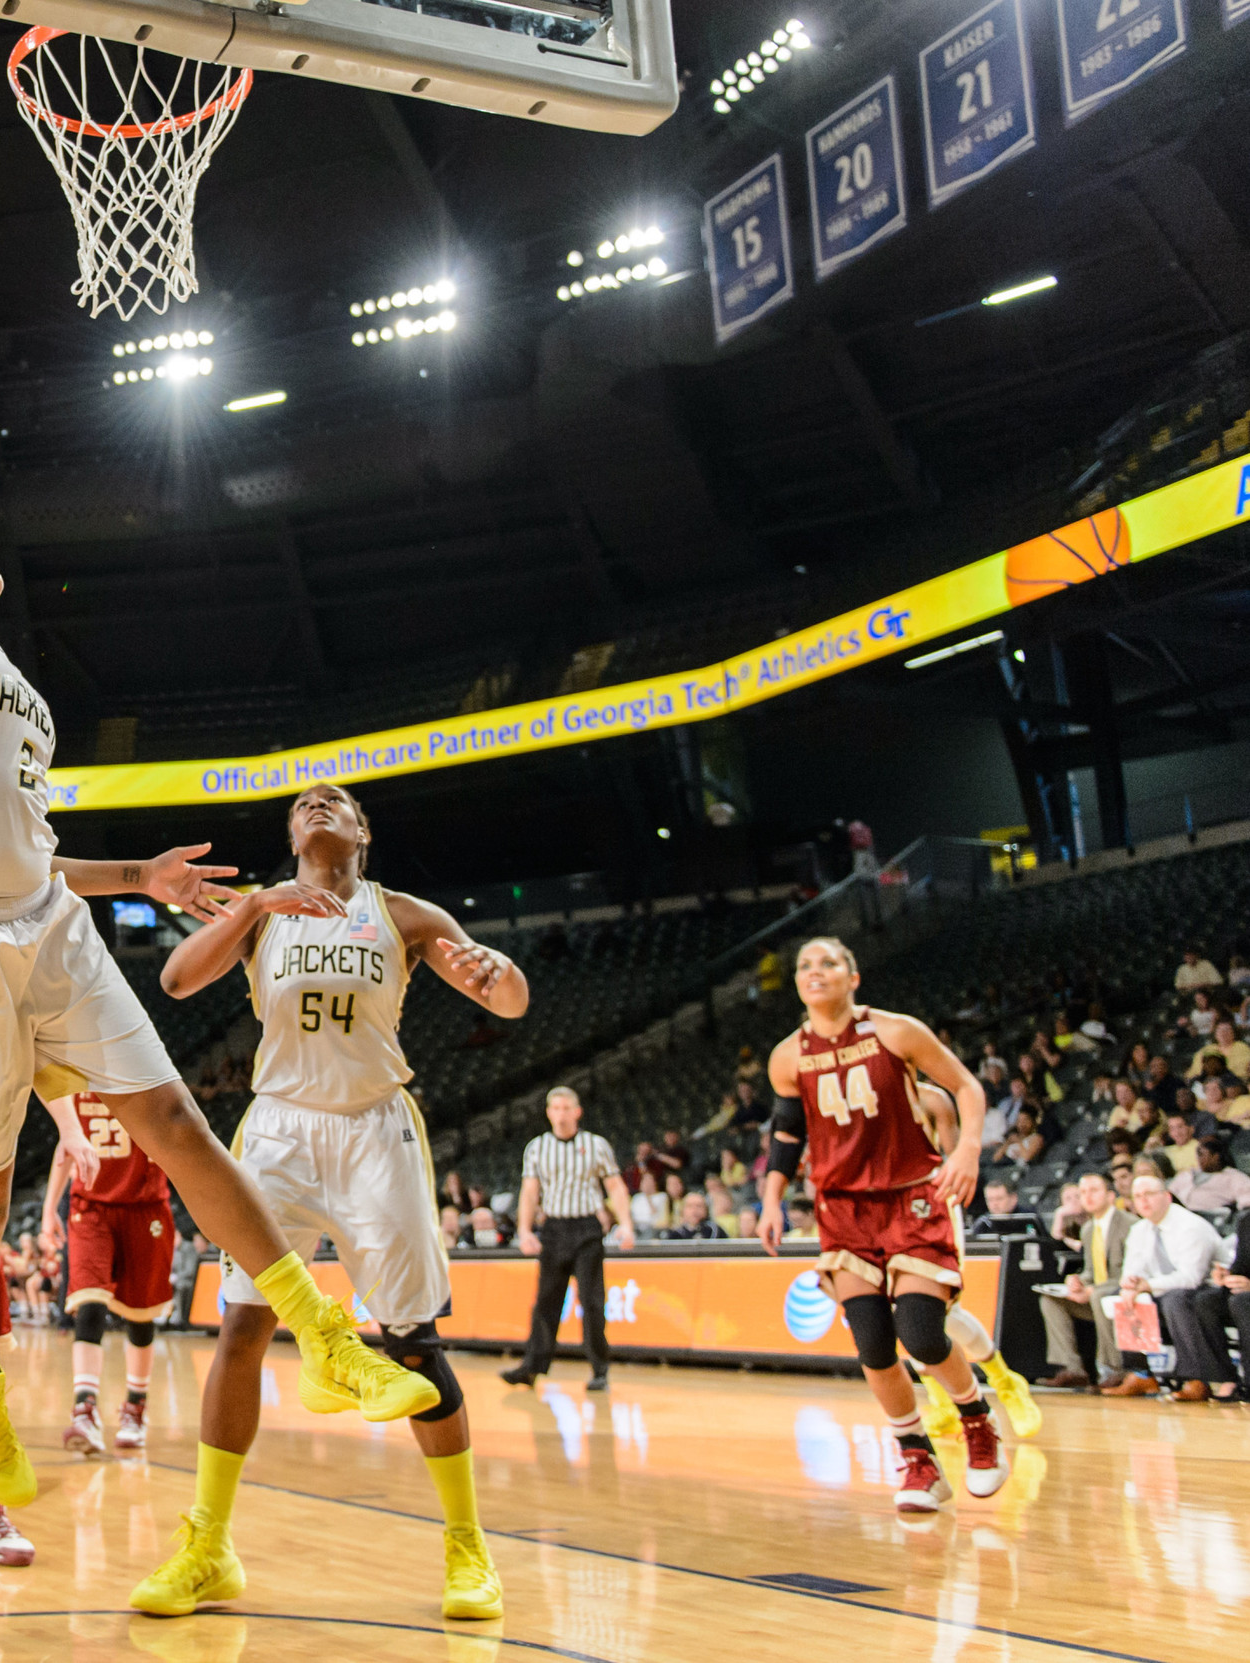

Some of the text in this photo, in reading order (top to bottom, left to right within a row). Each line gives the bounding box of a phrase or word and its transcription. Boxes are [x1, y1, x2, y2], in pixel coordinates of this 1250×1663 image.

[956, 59, 993, 123] 21
[834, 143, 873, 204] 20
[731, 215, 763, 269] 15
[202, 761, 288, 794] Official
[295, 742, 422, 784] Healthcare
[430, 720, 522, 757] Partner
[530, 708, 556, 739] of
[563, 690, 673, 729] Georgia
[757, 628, 862, 687] Athletics
[274, 945, 384, 984] JACKETS
[301, 992, 355, 1034] 54
[817, 1064, 879, 1126] 44
[89, 1118, 132, 1159] 23
